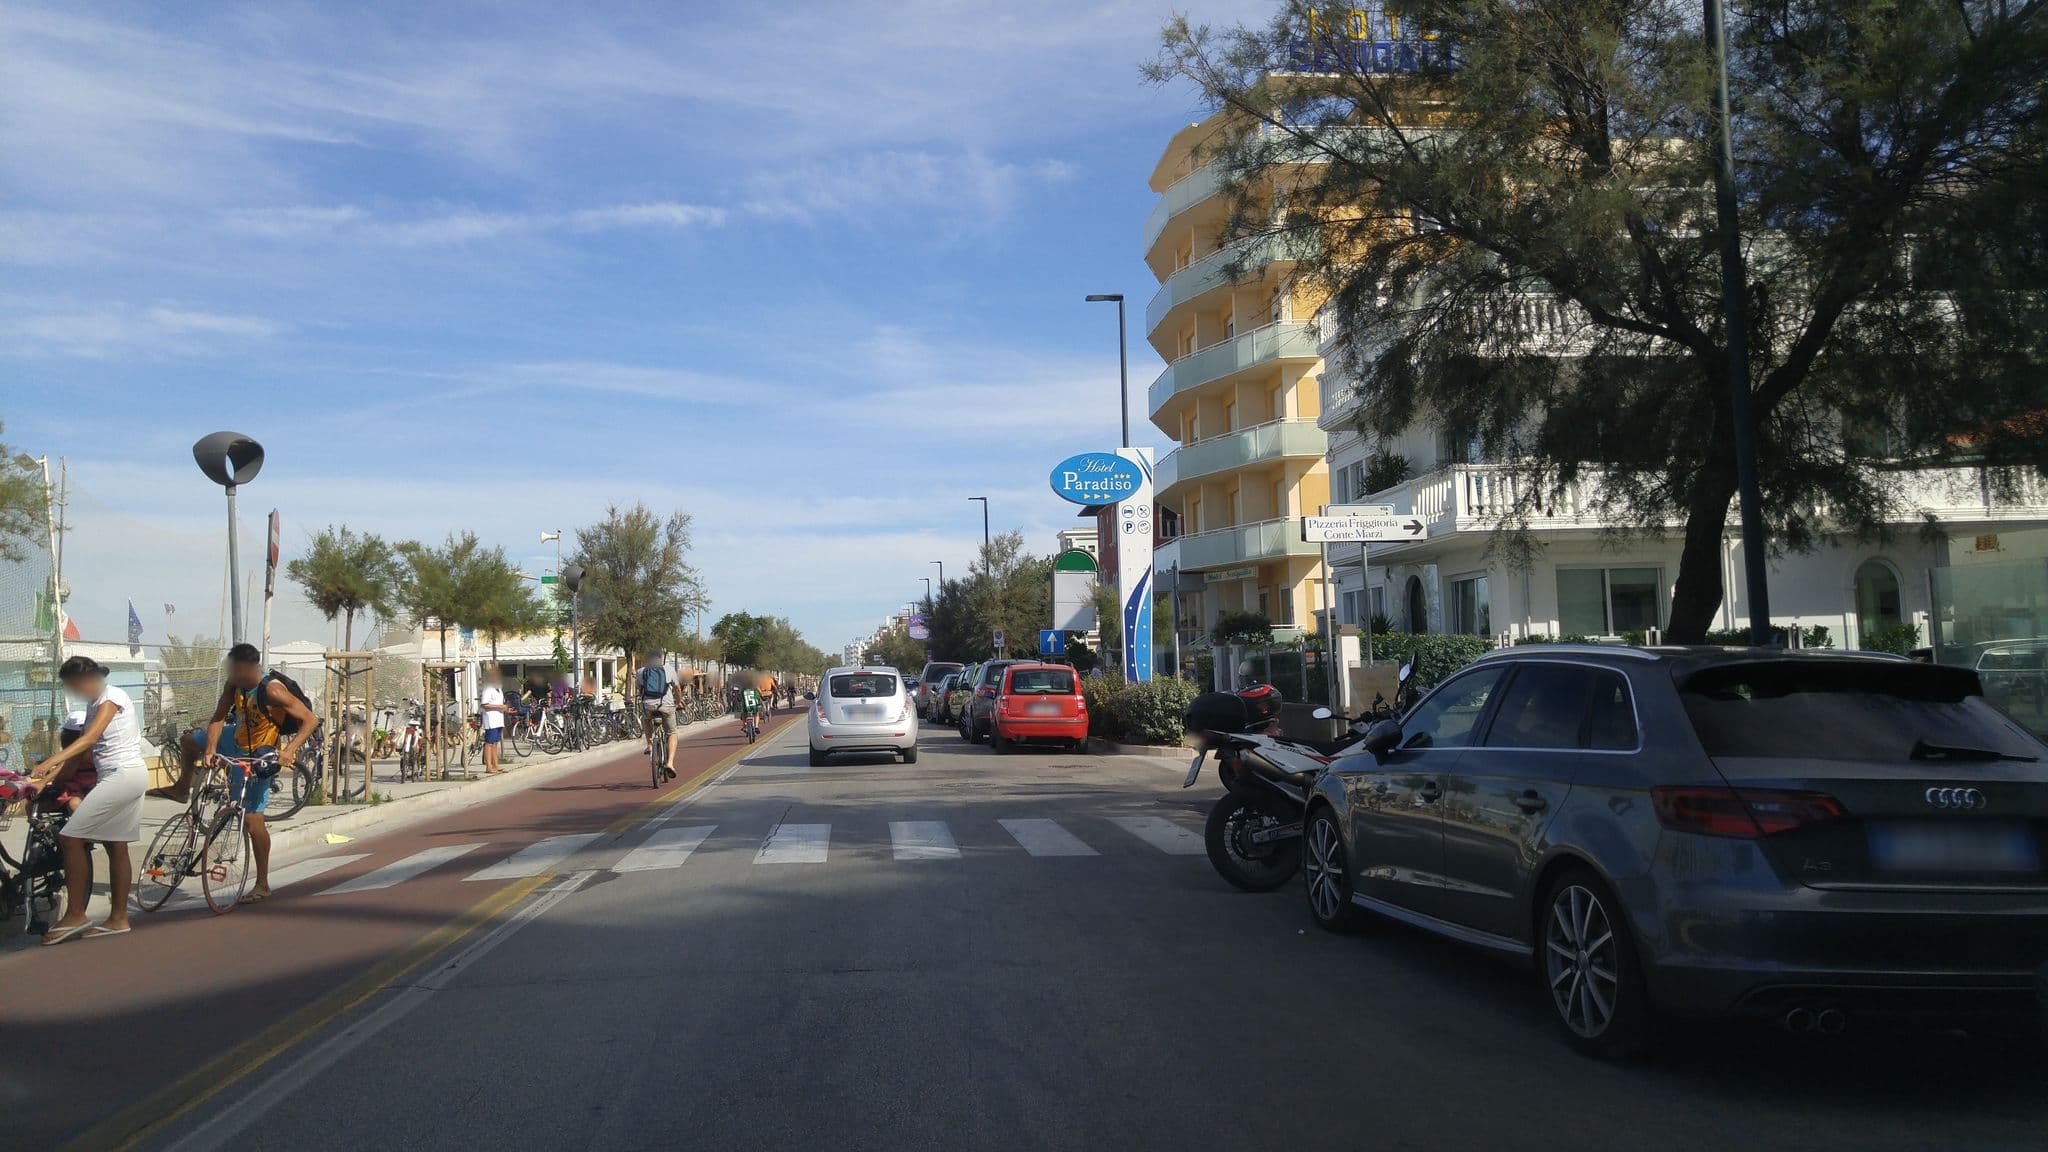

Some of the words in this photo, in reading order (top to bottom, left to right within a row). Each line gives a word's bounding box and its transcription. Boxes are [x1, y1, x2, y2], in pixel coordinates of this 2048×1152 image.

[1309, 7, 1474, 41] HOTE
[1078, 457, 1116, 473] Hotel
[1063, 472, 1132, 490] Paradiso
[1309, 519, 1347, 528] Pizzeria
[1349, 518, 1398, 529] Friggitoria
[1324, 530, 1353, 539] Conte
[1356, 529, 1383, 538] Marzi
